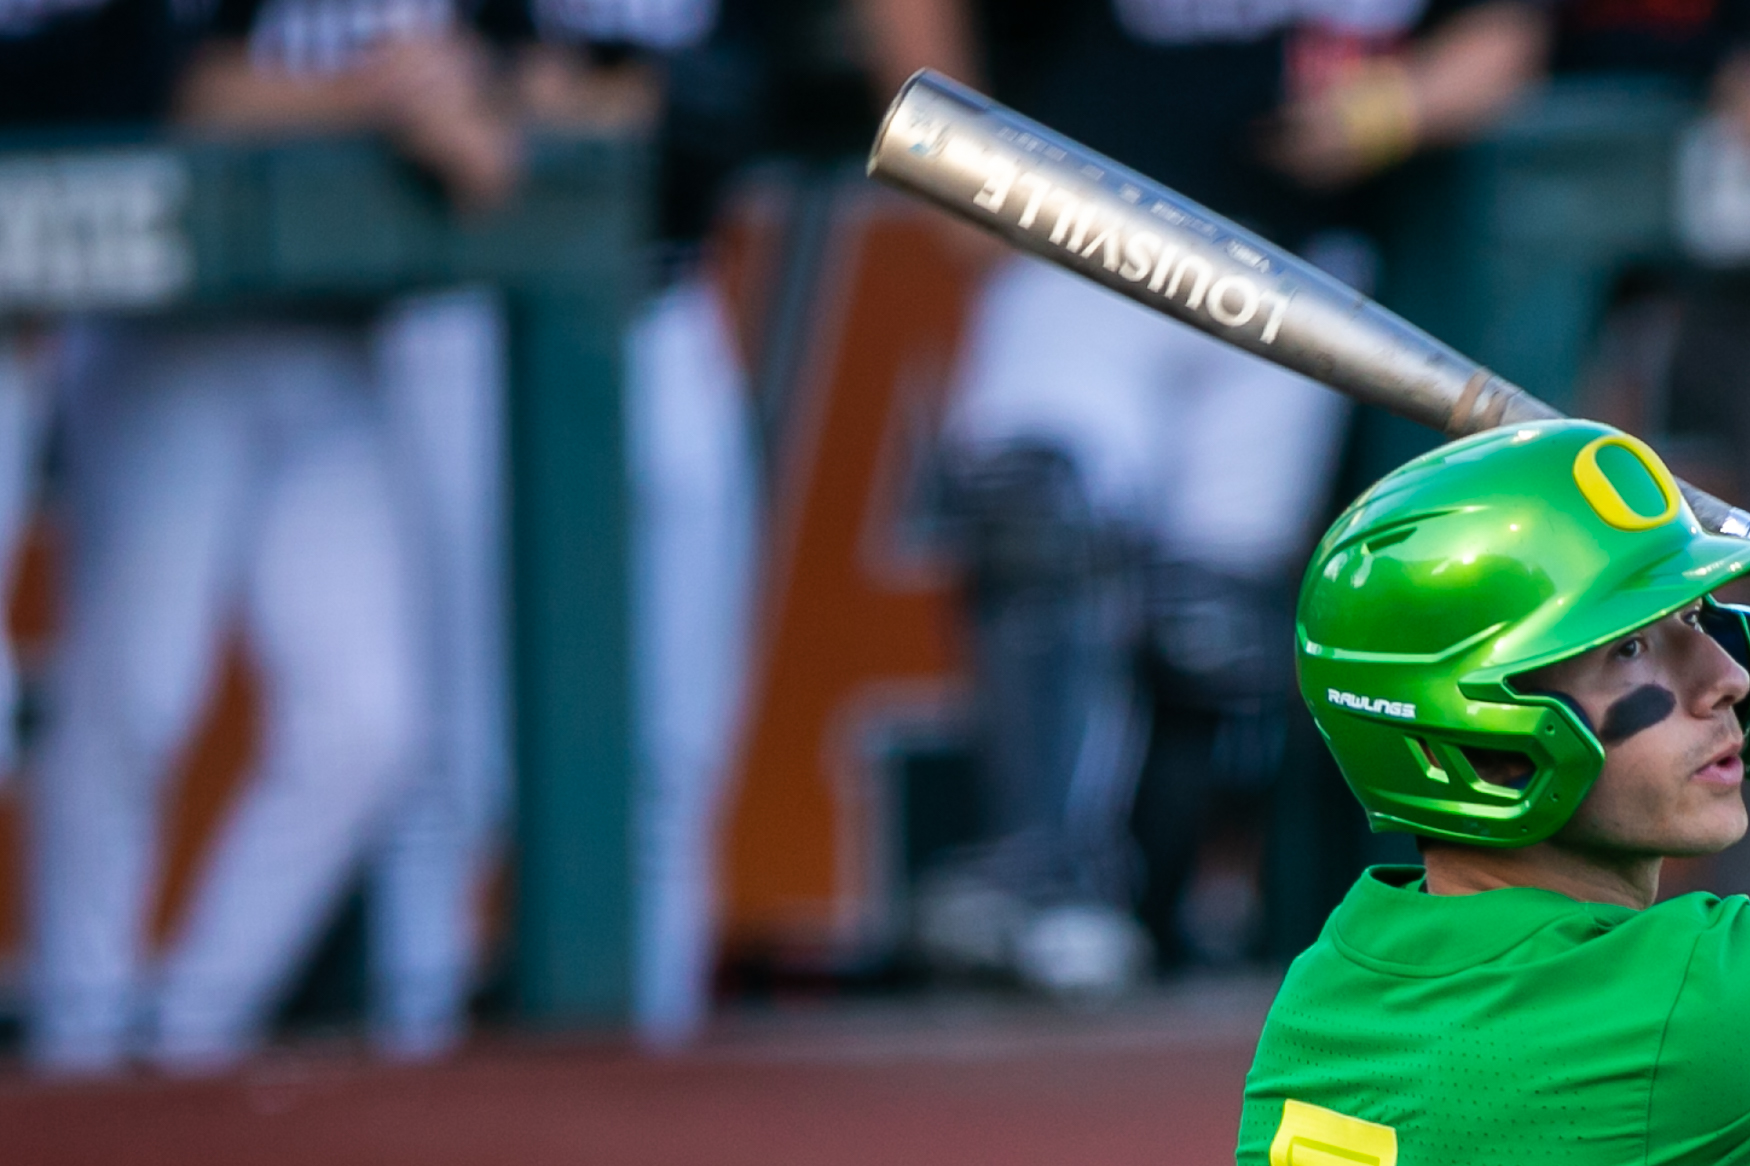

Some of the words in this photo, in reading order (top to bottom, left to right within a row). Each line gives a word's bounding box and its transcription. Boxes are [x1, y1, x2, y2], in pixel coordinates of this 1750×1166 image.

[972, 154, 1291, 345] LOUISVILLE
[1573, 434, 1680, 532] O
[1327, 687, 1416, 719] RAWLINGS
